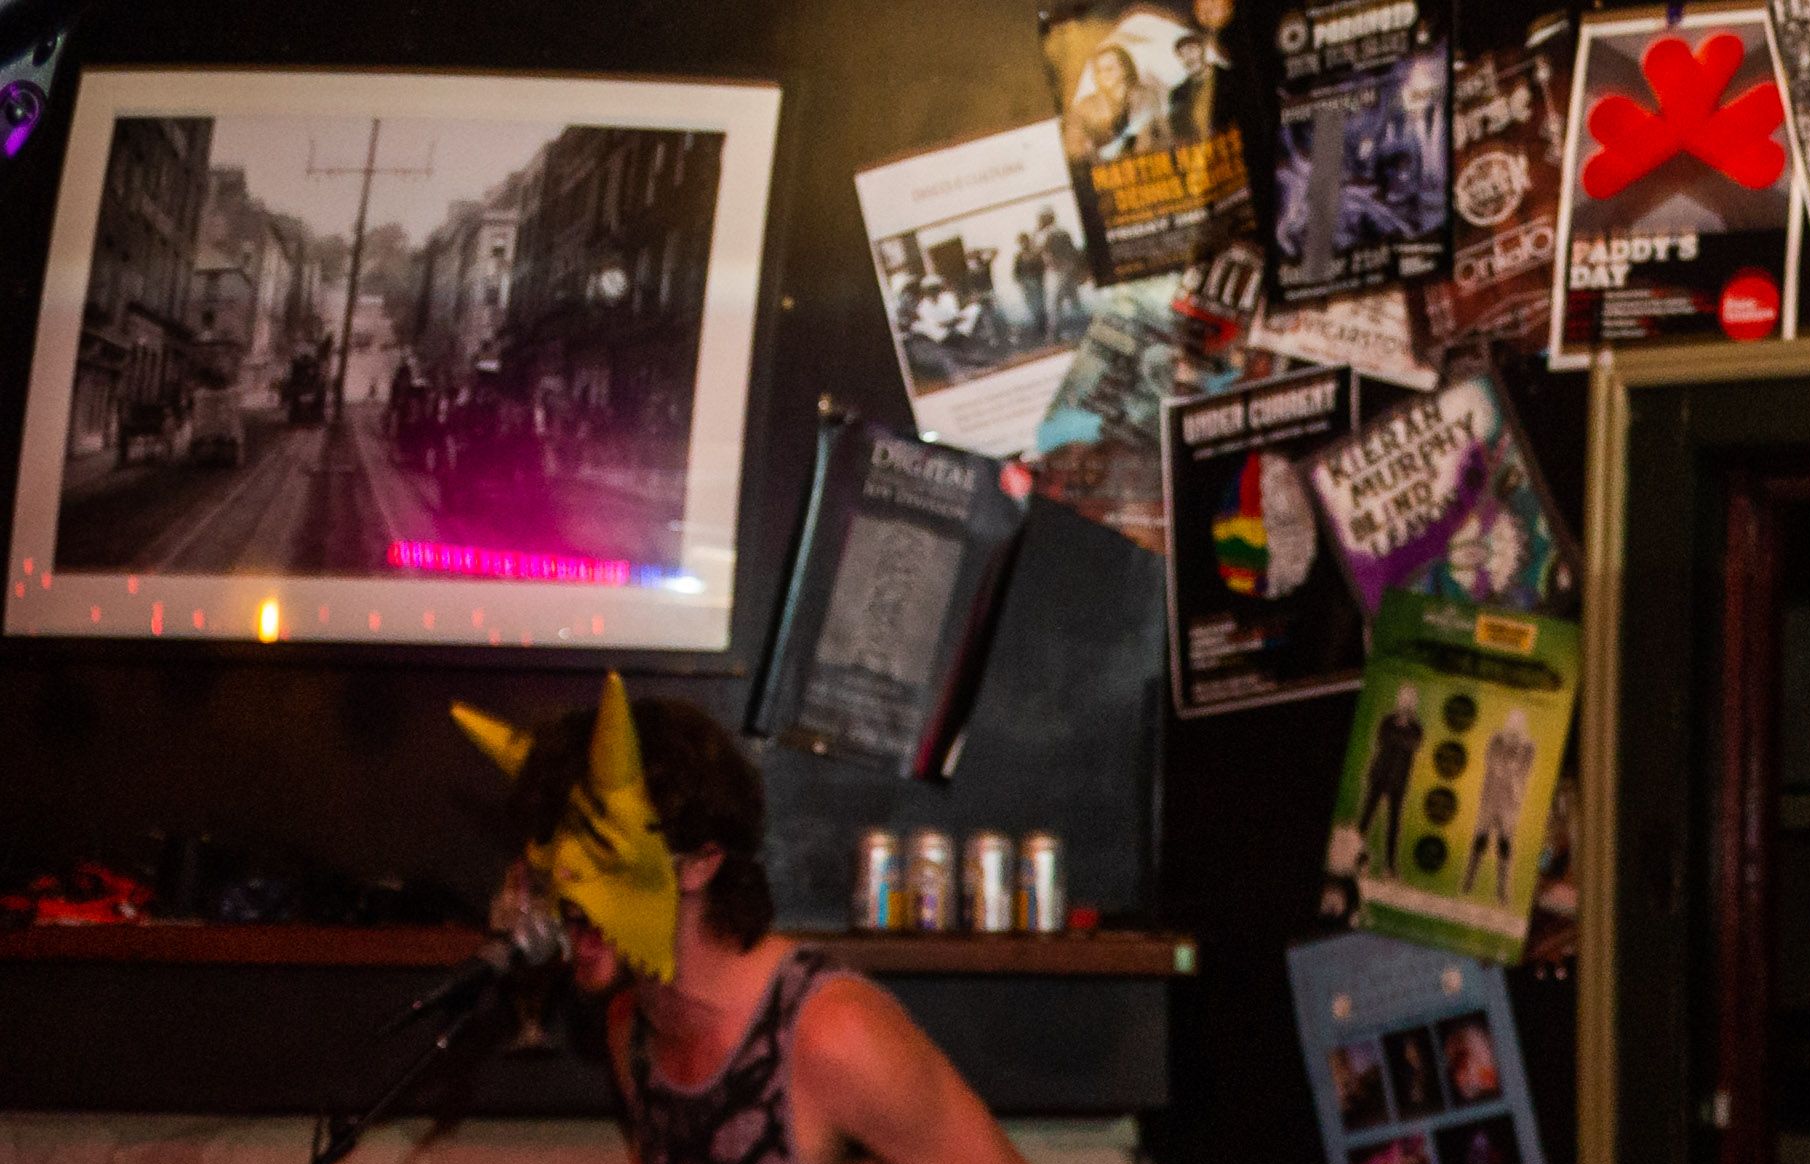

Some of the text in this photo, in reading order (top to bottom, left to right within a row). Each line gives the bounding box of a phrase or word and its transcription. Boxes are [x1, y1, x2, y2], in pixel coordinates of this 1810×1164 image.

[1569, 263, 1632, 290] DAY
[1570, 234, 1698, 263] PADDY'S
[1326, 400, 1443, 488] KIERAN
[1351, 409, 1473, 508] MURPHY
